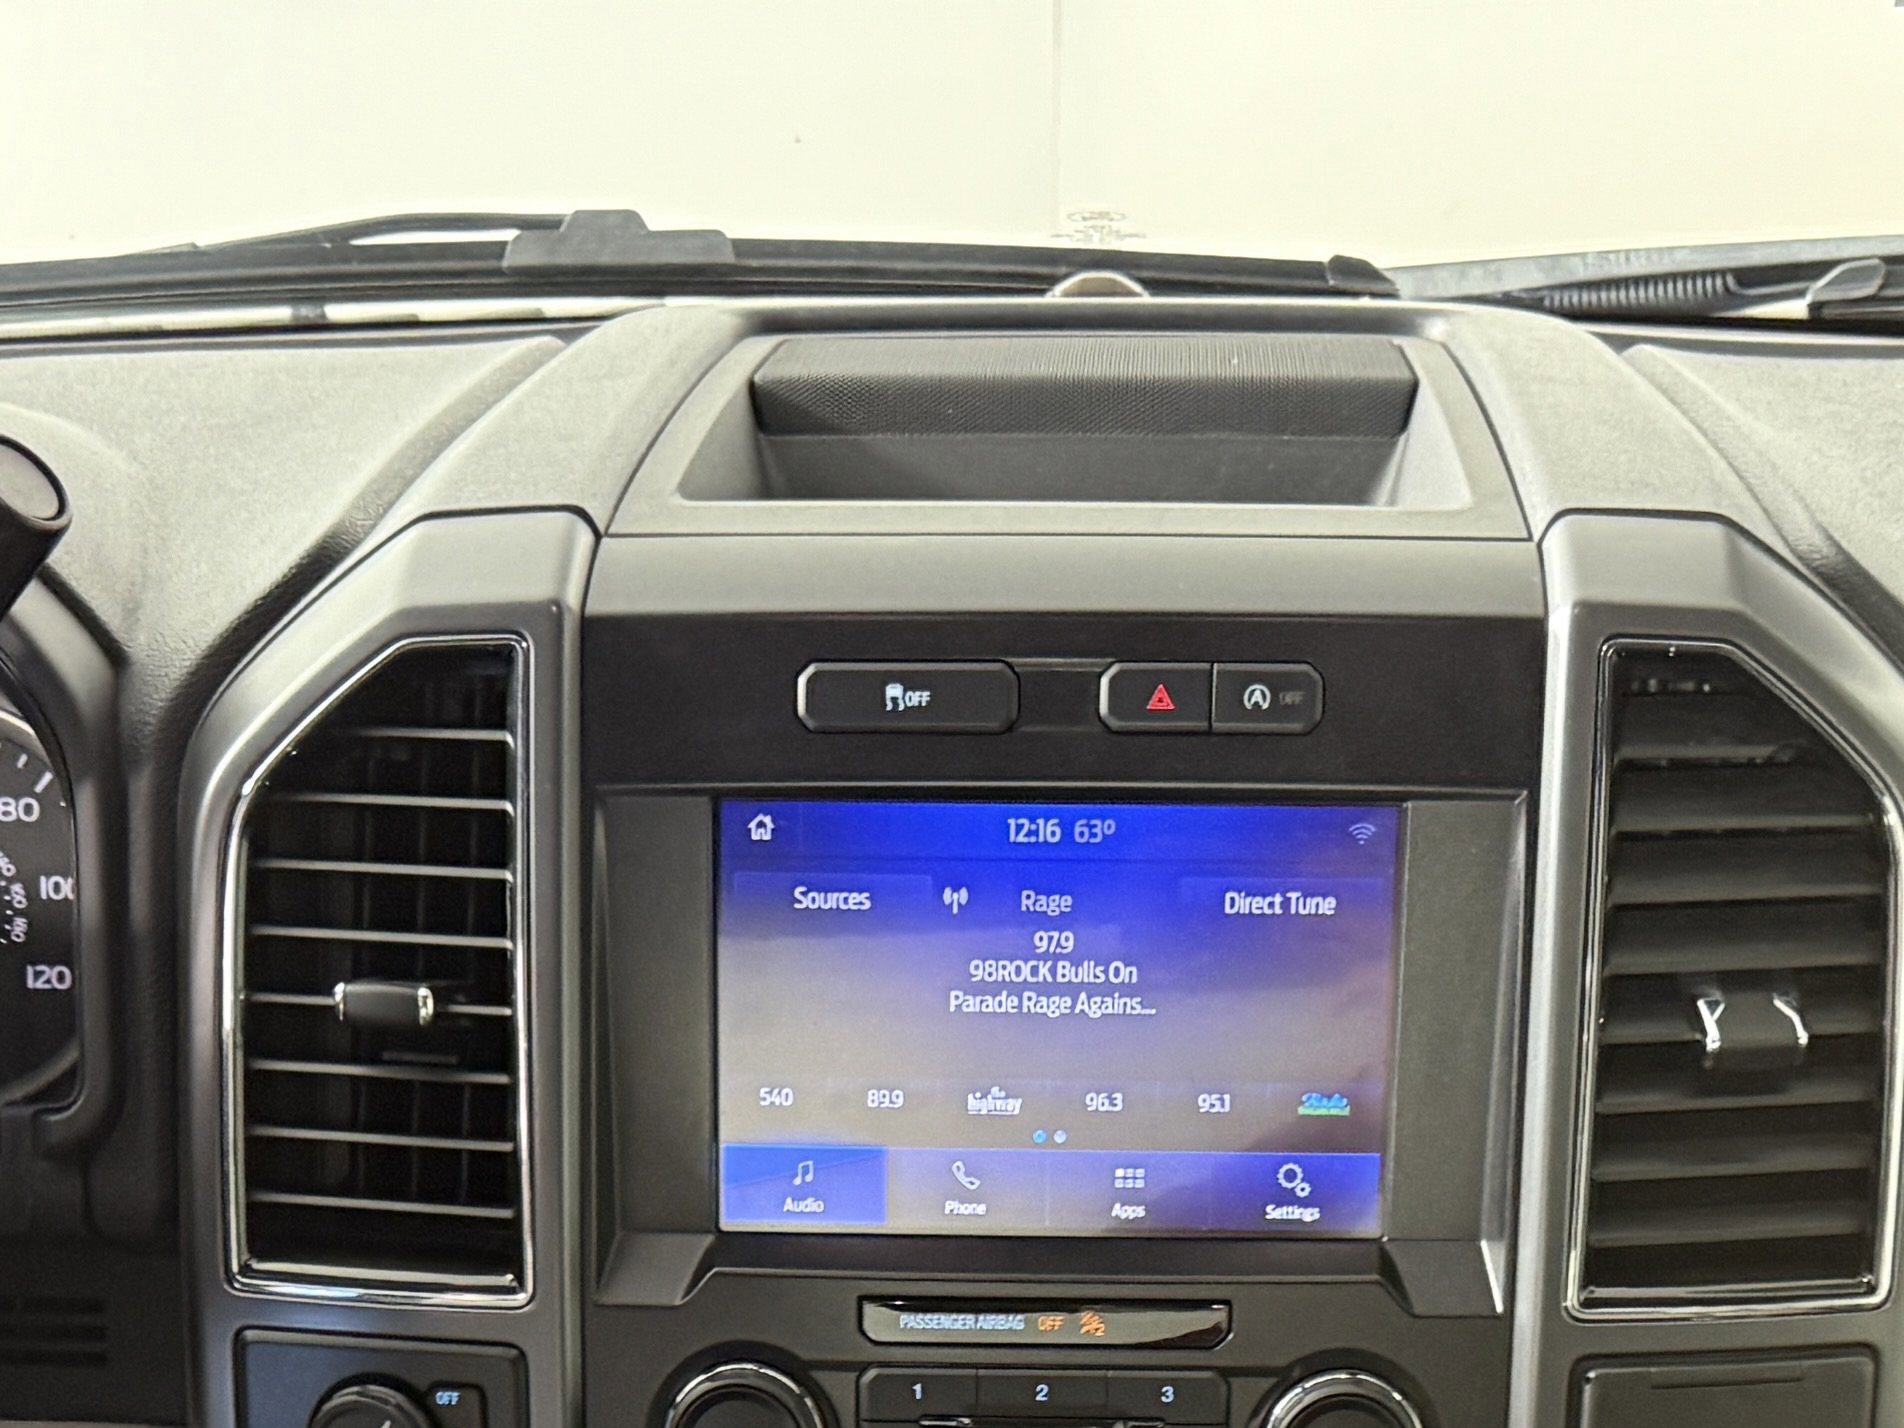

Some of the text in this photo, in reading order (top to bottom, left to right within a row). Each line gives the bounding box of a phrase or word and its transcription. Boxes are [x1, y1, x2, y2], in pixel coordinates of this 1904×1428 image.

[905, 690, 931, 707] OFF
[1007, 818, 1061, 843] 12:16
[794, 886, 871, 910] Sources
[1021, 891, 1073, 917] Rage
[1224, 891, 1336, 915] Direct Tune
[1033, 931, 1074, 953] 97.9
[26, 964, 73, 990] 120
[969, 960, 1137, 985] 98ROCK Bulls On
[949, 991, 1157, 1018] Parade Rage Agains...
[759, 1087, 794, 1106] 540
[967, 1093, 1022, 1114] highway
[1085, 1092, 1124, 1112] 96.3
[783, 1197, 824, 1213] Audio
[944, 1200, 987, 1216] Phone
[1111, 1203, 1146, 1220] Apps
[1265, 1204, 1320, 1222] Settings
[899, 1313, 1065, 1331] PASSENGER AIRBAG OFF
[435, 1392, 461, 1405] OFF
[912, 1383, 922, 1399] 1
[1035, 1384, 1048, 1400] 2
[1161, 1386, 1174, 1403] 3
